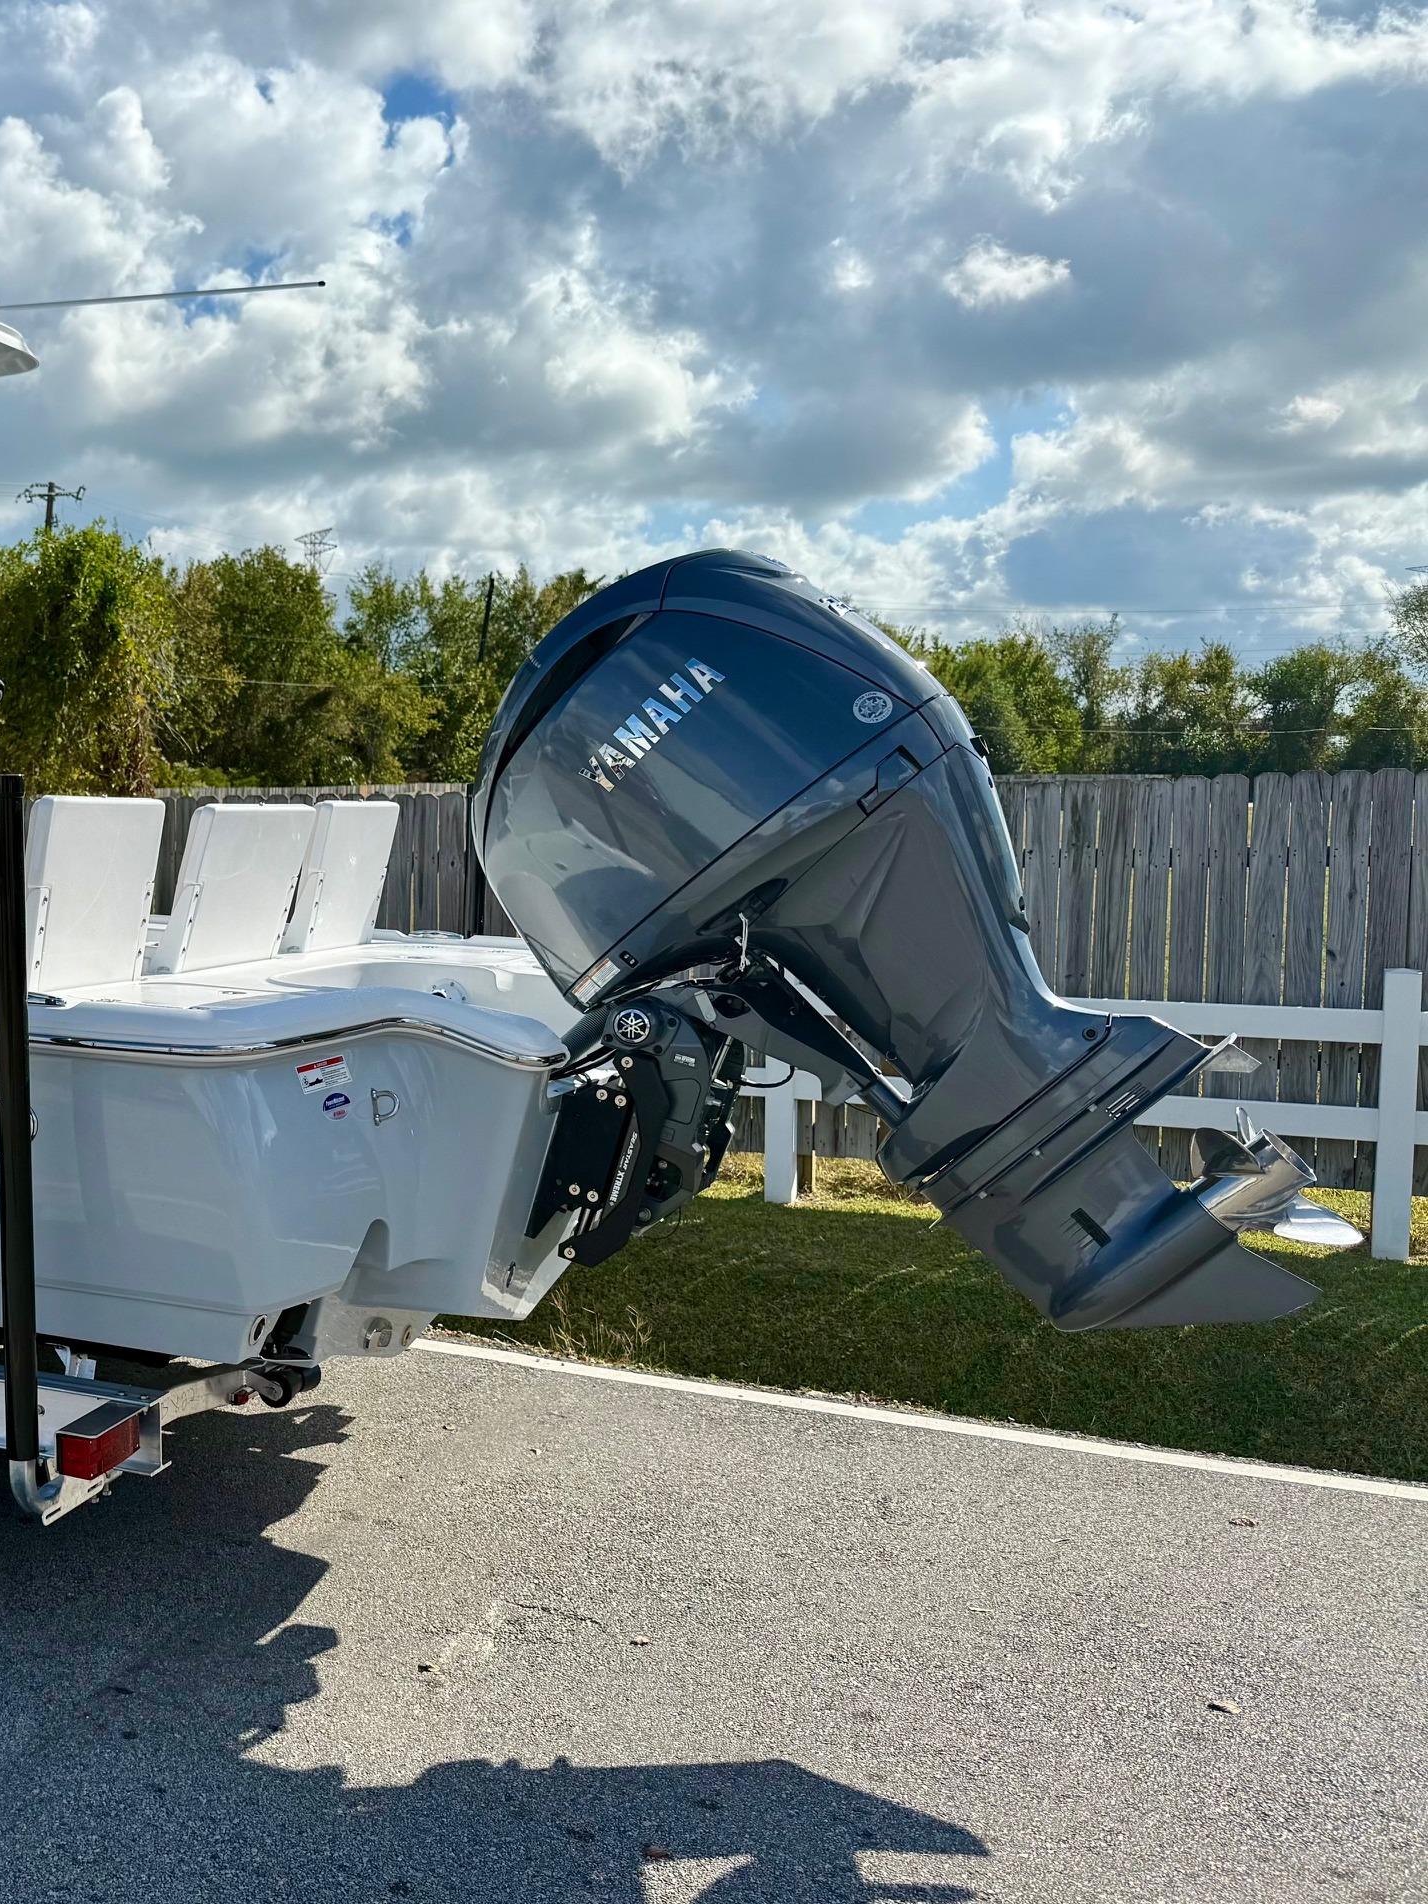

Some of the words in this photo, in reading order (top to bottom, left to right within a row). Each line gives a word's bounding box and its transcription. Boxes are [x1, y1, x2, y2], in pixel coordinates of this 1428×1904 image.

[578, 657, 726, 793] YAMAHA
[622, 1131, 638, 1171] SEASTAR
[609, 1170, 626, 1203] XTREME
